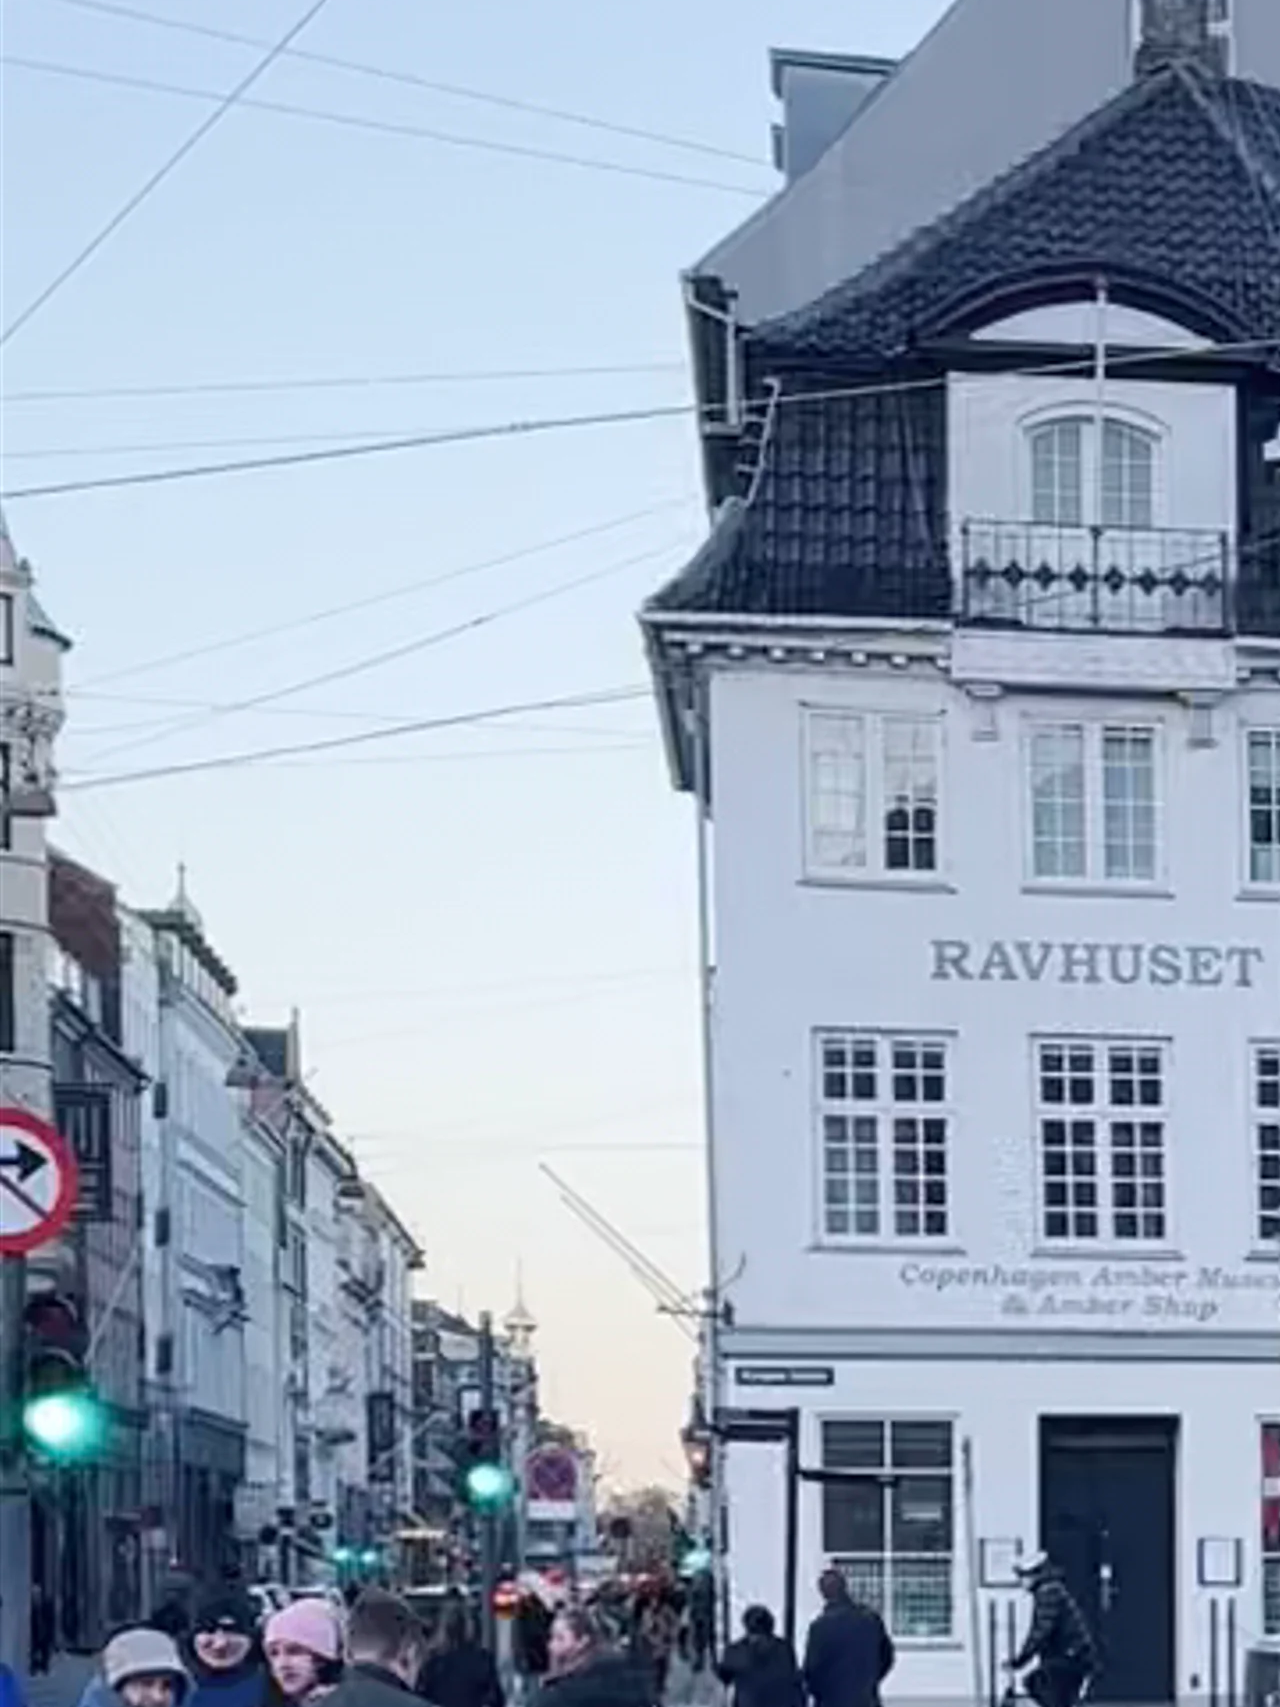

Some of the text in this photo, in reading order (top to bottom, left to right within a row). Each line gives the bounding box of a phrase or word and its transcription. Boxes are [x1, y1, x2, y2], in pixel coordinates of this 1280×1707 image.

[930, 939, 1265, 988] RAVHUSET
[899, 1263, 1082, 1291] Copenhagen
[1090, 1265, 1188, 1290] Amber
[1037, 1294, 1134, 1316] Amber
